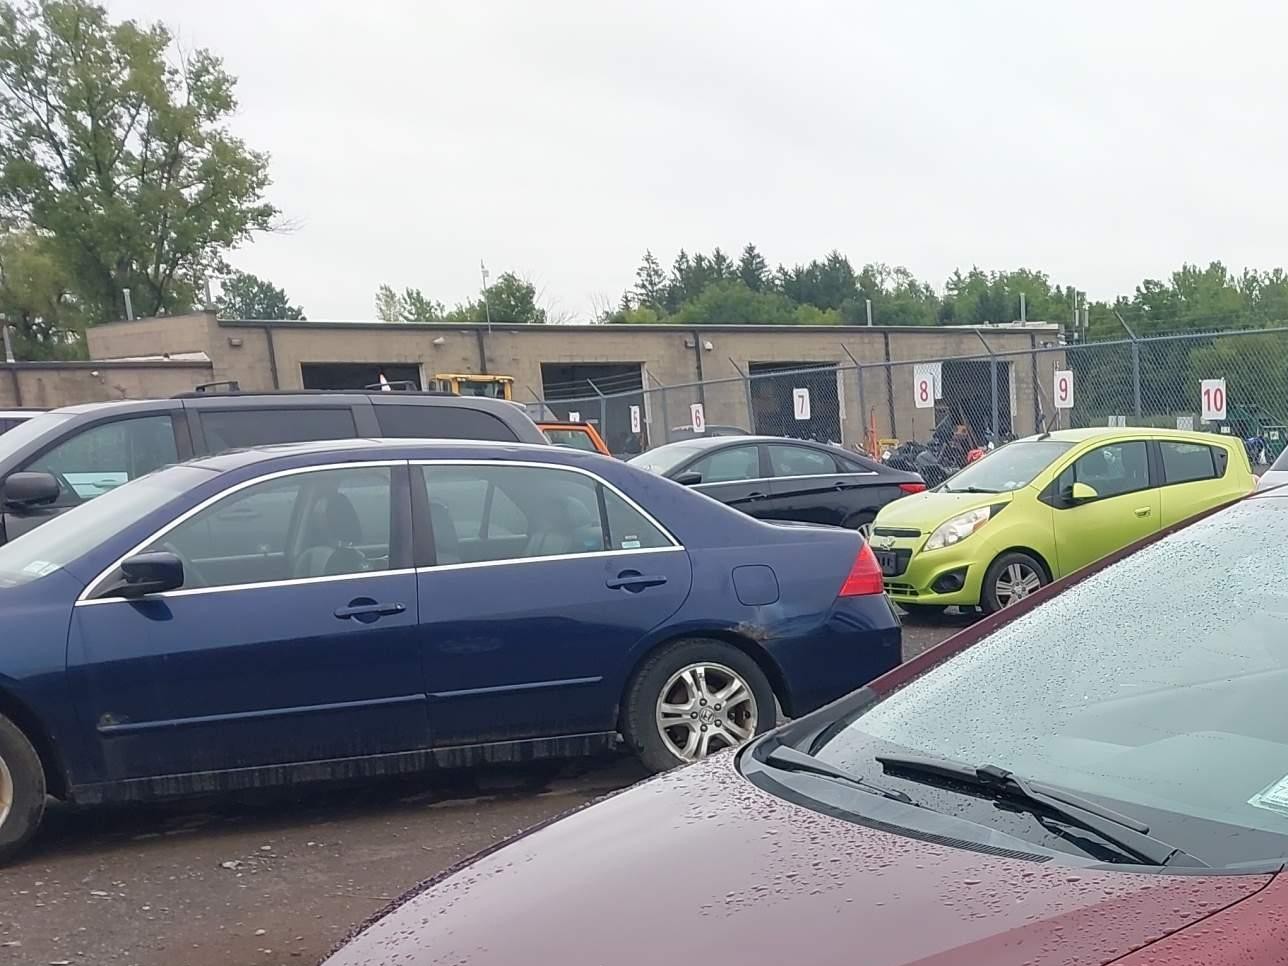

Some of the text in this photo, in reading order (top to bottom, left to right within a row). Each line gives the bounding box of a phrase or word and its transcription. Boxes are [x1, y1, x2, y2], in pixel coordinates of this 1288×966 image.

[919, 380, 929, 402] 8
[1058, 377, 1069, 402] 9
[1203, 387, 1224, 413] 10
[797, 394, 805, 415] 7
[693, 409, 702, 429] 6
